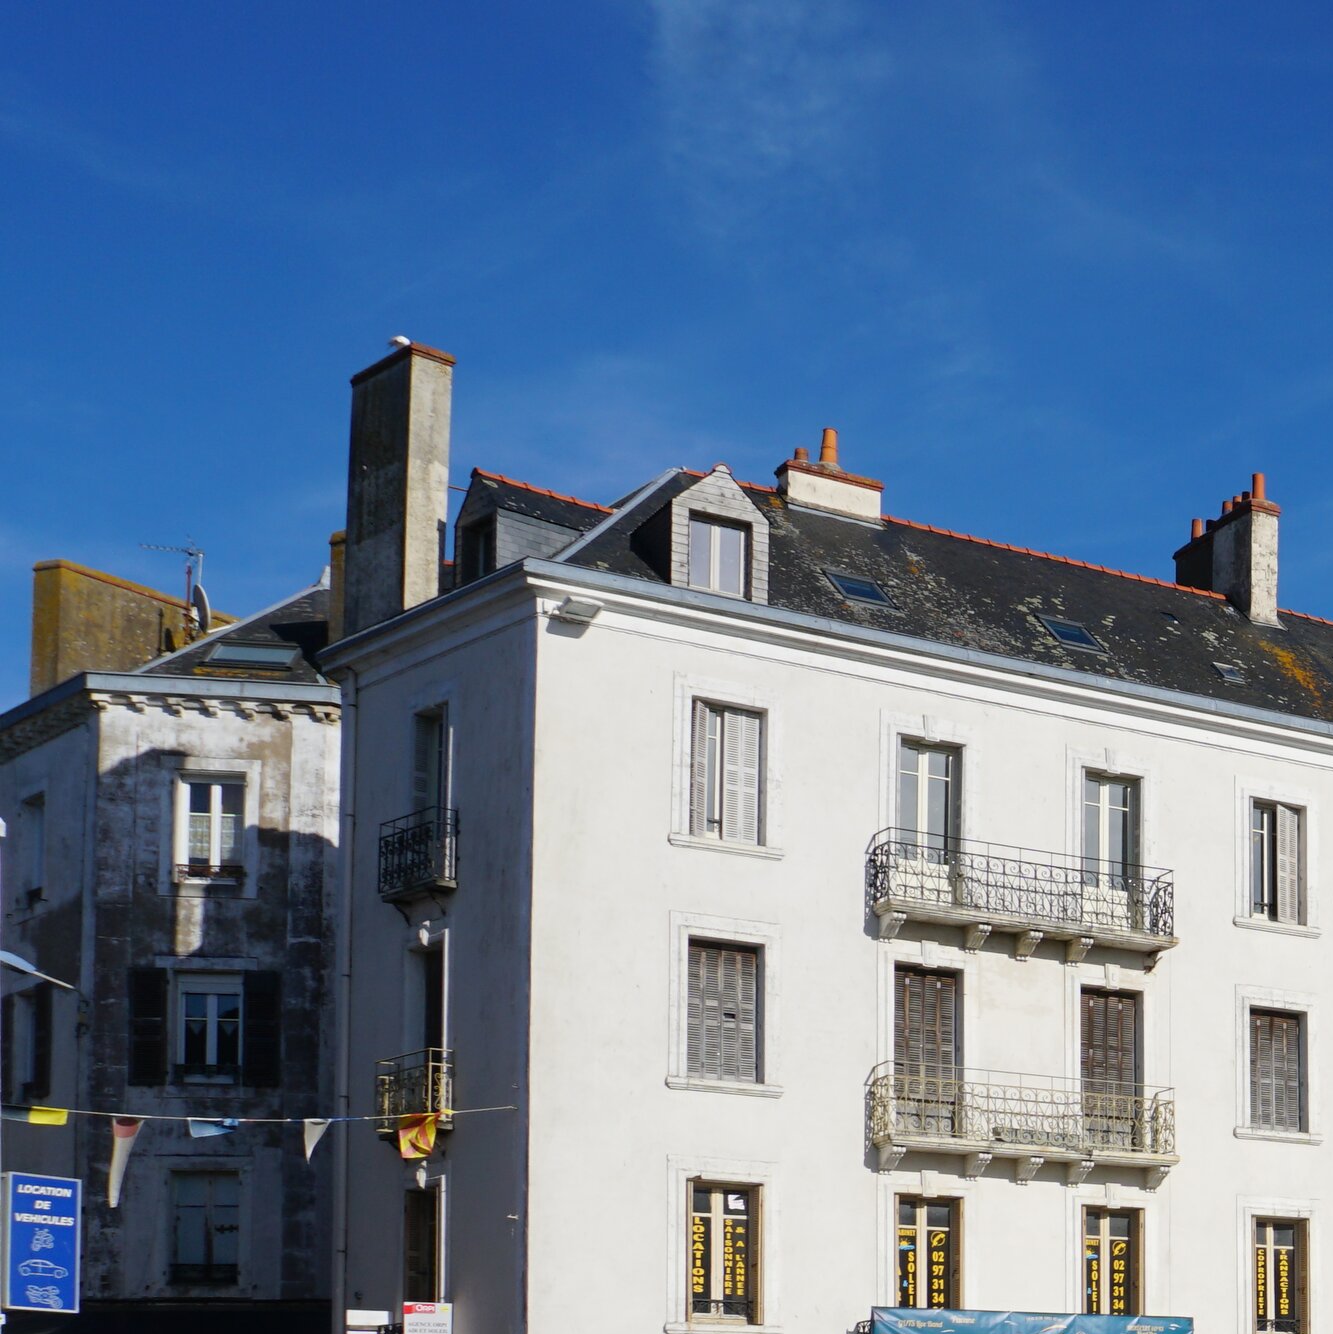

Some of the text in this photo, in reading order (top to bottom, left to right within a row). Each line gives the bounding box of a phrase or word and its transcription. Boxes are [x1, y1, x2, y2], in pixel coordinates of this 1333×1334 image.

[17, 1184, 72, 1197] LOCATION
[34, 1200, 52, 1210] DE
[15, 1212, 75, 1226] VEHICULES
[693, 1216, 705, 1293] LOCATIONS
[724, 1219, 733, 1295] SAISONNIERE
[932, 1251, 944, 1303] 02 97 31 34
[1113, 1260, 1125, 1310] 02 97 31 34
[1280, 1249, 1289, 1315] TRANSACTIONS
